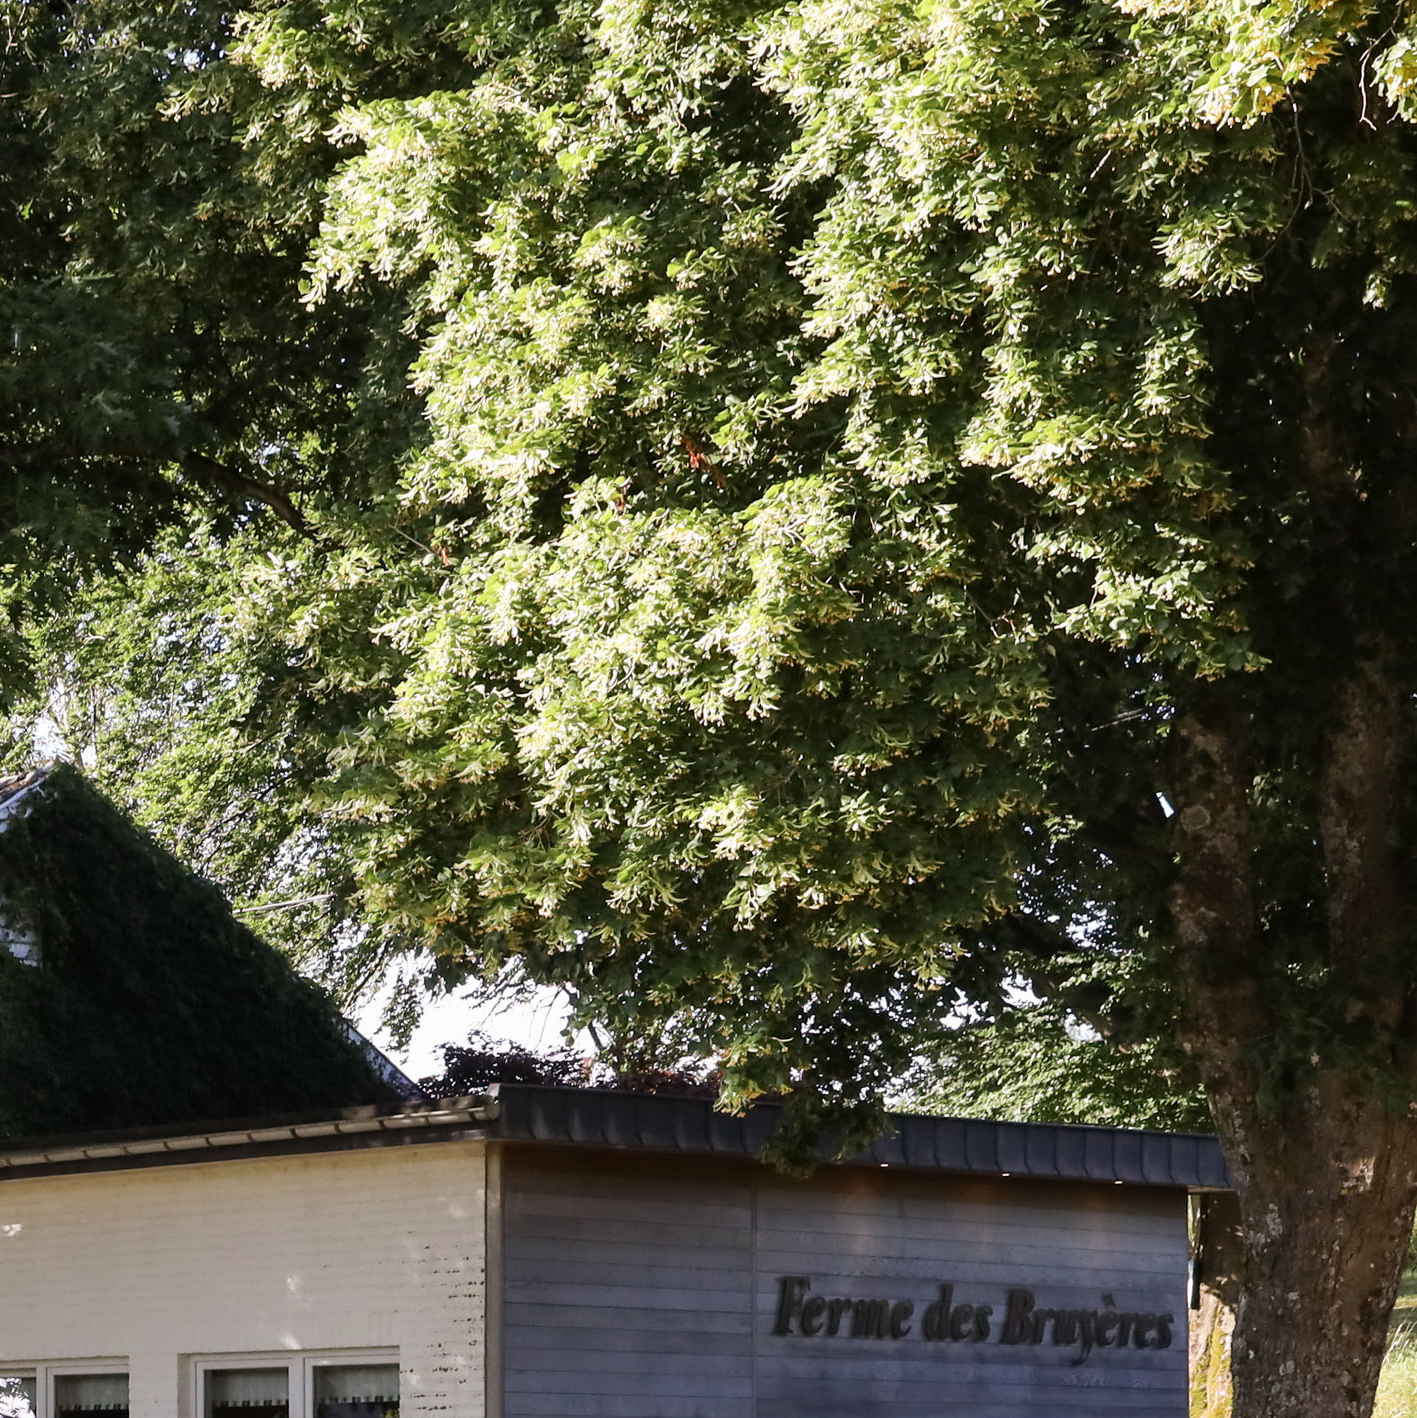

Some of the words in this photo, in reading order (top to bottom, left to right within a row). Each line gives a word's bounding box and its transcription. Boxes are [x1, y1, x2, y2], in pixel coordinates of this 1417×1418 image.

[771, 1275, 915, 1338] Ferme
[921, 1283, 994, 1341] des
[998, 1287, 1174, 1366] Bruyères
